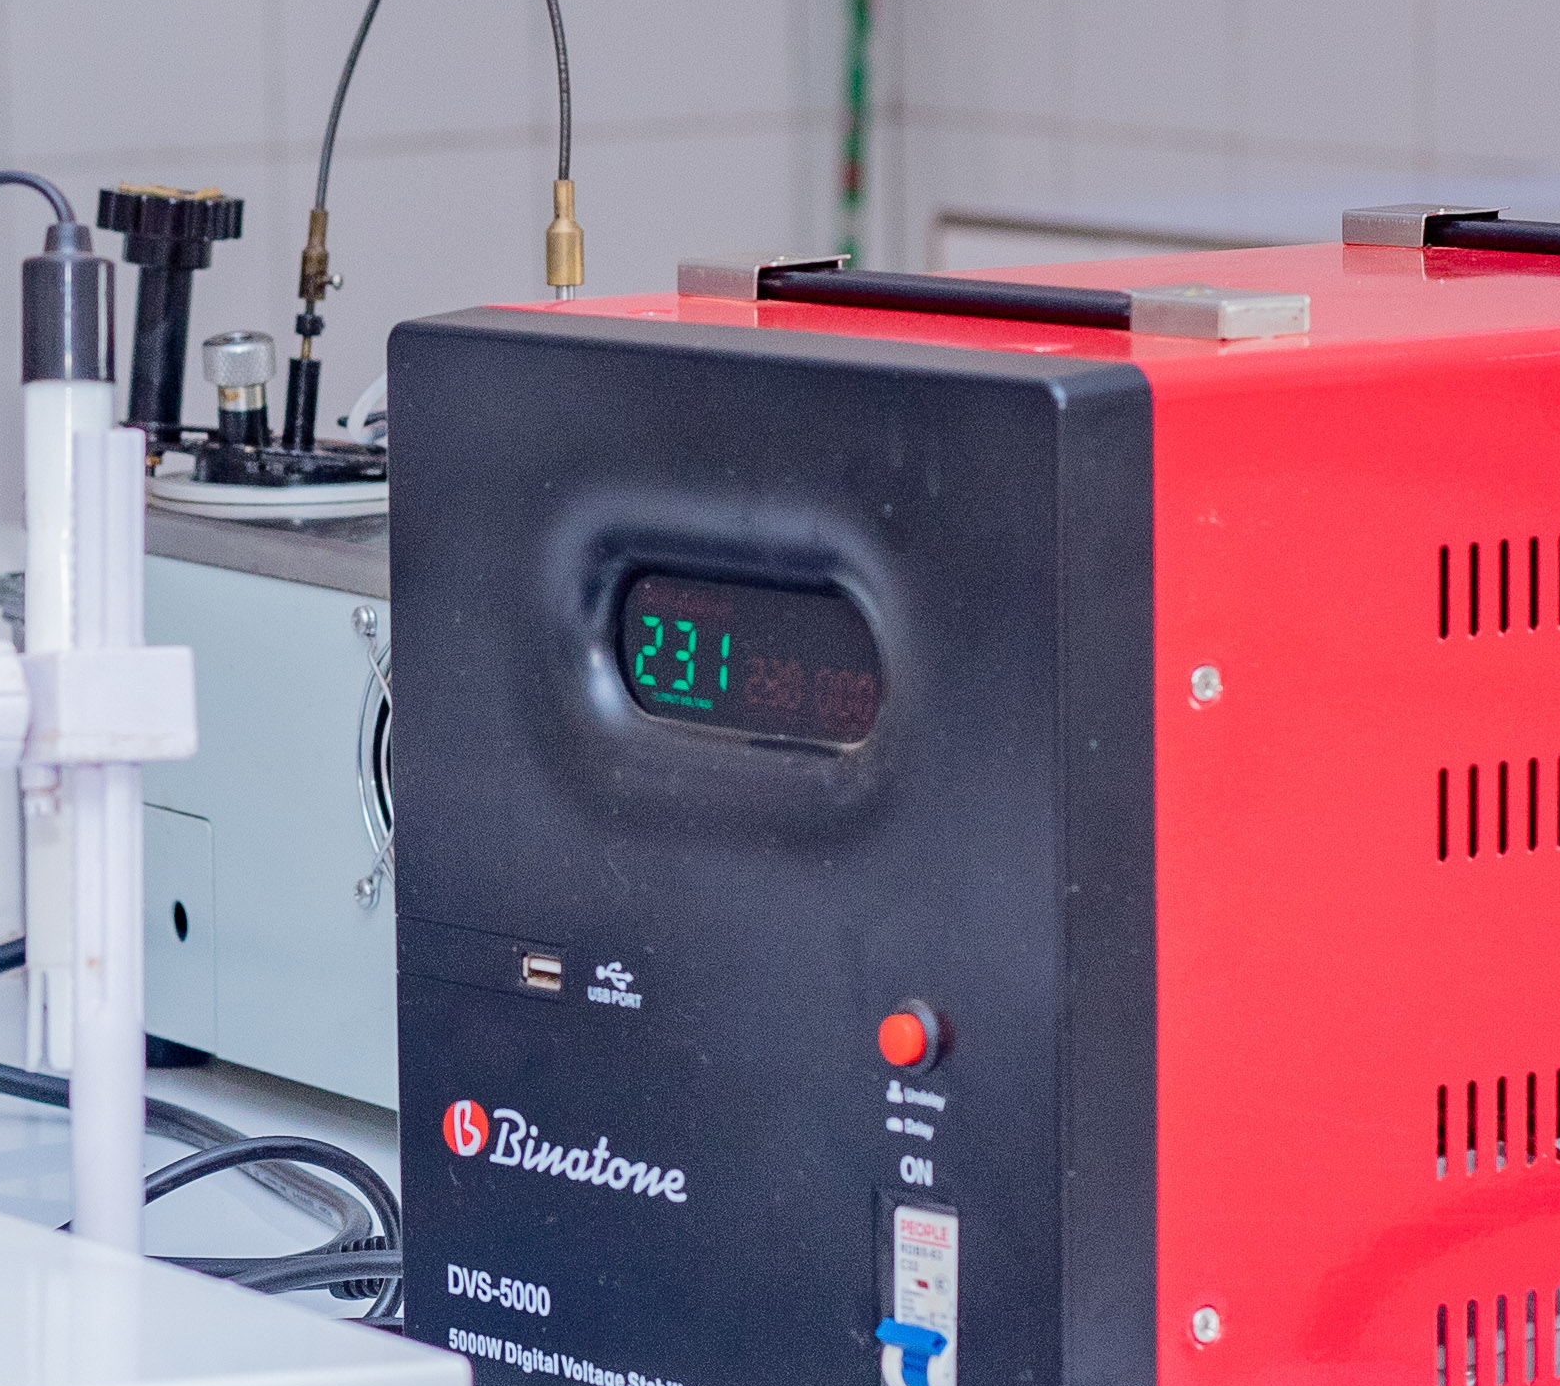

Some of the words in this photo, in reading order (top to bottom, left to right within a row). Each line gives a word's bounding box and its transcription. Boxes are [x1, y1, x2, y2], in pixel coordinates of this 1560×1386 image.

[634, 614, 731, 692] 231
[587, 985, 611, 1005] USB
[611, 989, 642, 1010] PORT
[488, 1107, 688, 1203] Binatone
[900, 1154, 934, 1187] ON
[447, 1262, 551, 1317] DVS-5000
[448, 1327, 503, 1361] 5000W
[504, 1340, 560, 1376] Digital
